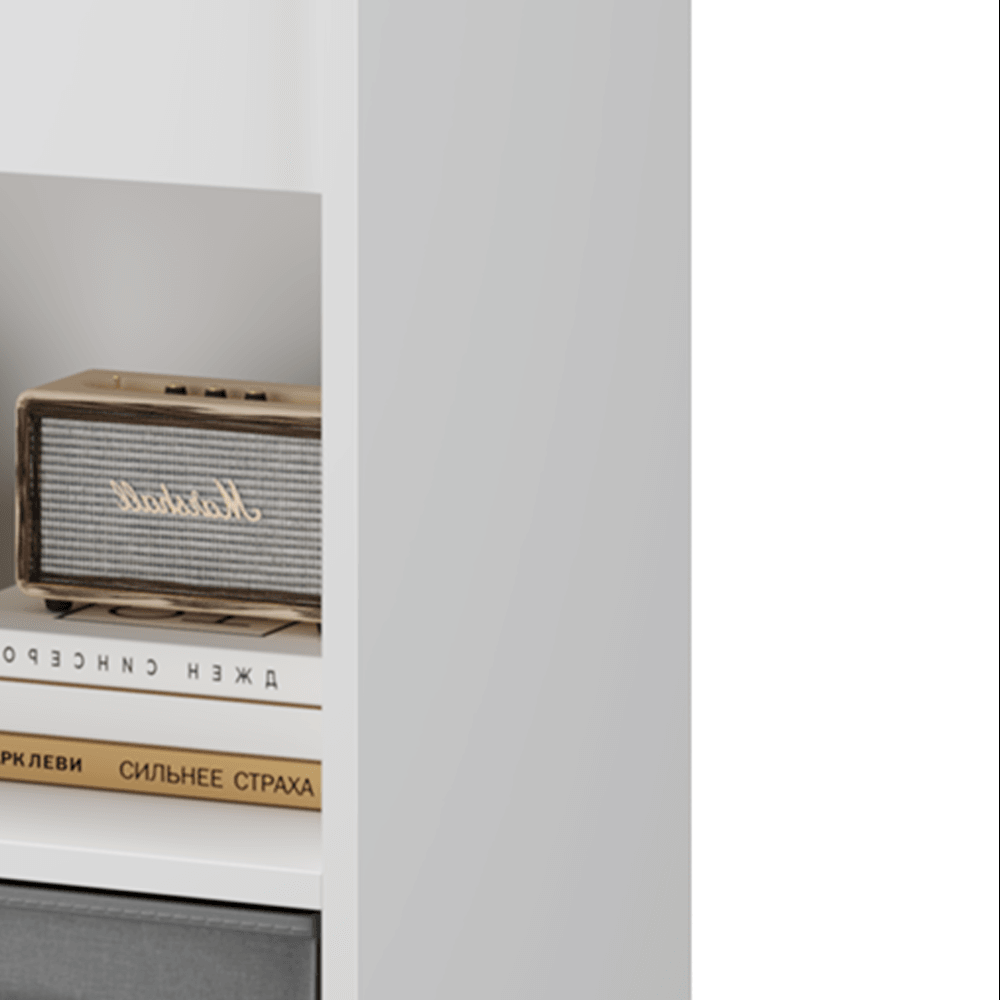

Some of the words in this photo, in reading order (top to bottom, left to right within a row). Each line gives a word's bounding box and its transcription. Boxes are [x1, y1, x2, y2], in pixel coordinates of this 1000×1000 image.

[29, 753, 82, 772] ЛЕВИ
[119, 760, 223, 789] СИЛЬНЕЕ
[233, 771, 315, 797] СТРАХА
